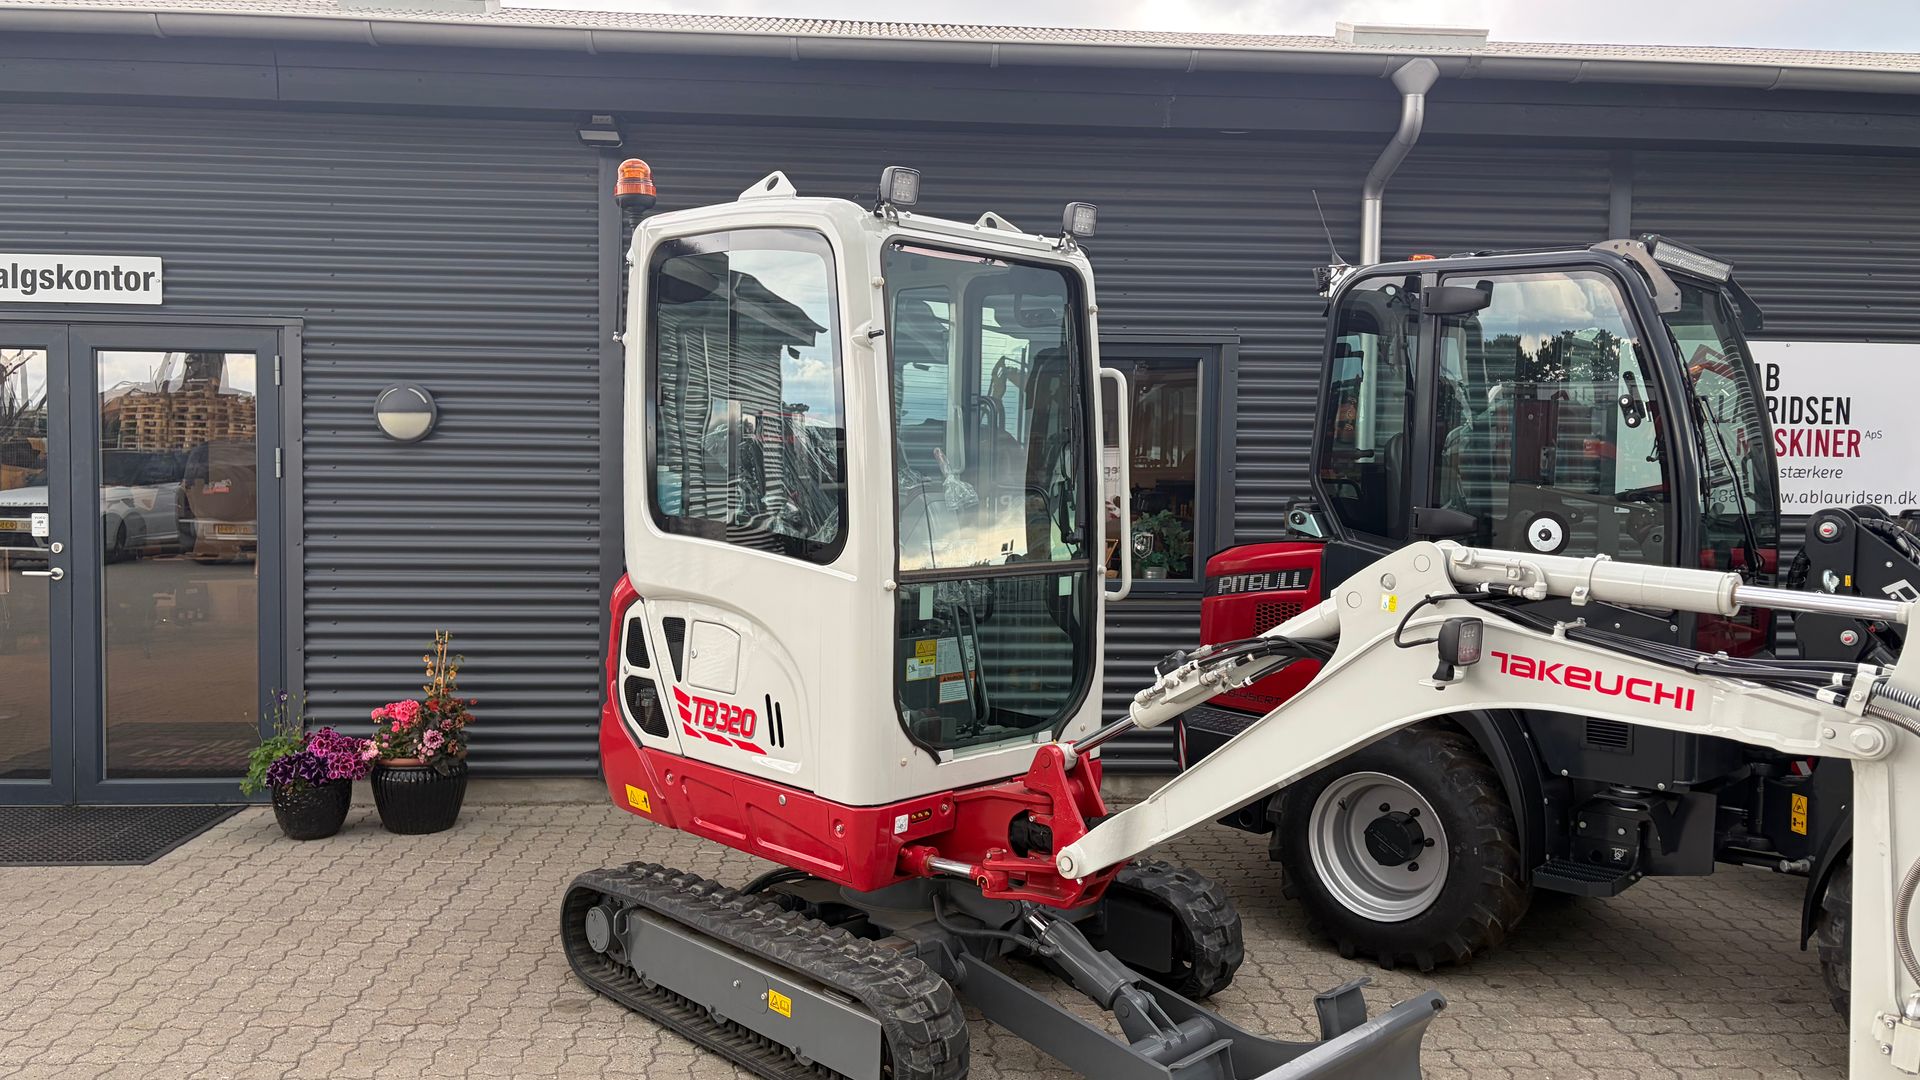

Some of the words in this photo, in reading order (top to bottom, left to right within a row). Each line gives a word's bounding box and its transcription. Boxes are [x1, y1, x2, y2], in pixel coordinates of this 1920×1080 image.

[1864, 430, 1883, 440] ApS
[1780, 465, 1844, 479] stærkere
[1217, 571, 1306, 594] PITBULL
[692, 695, 757, 739] TB320
